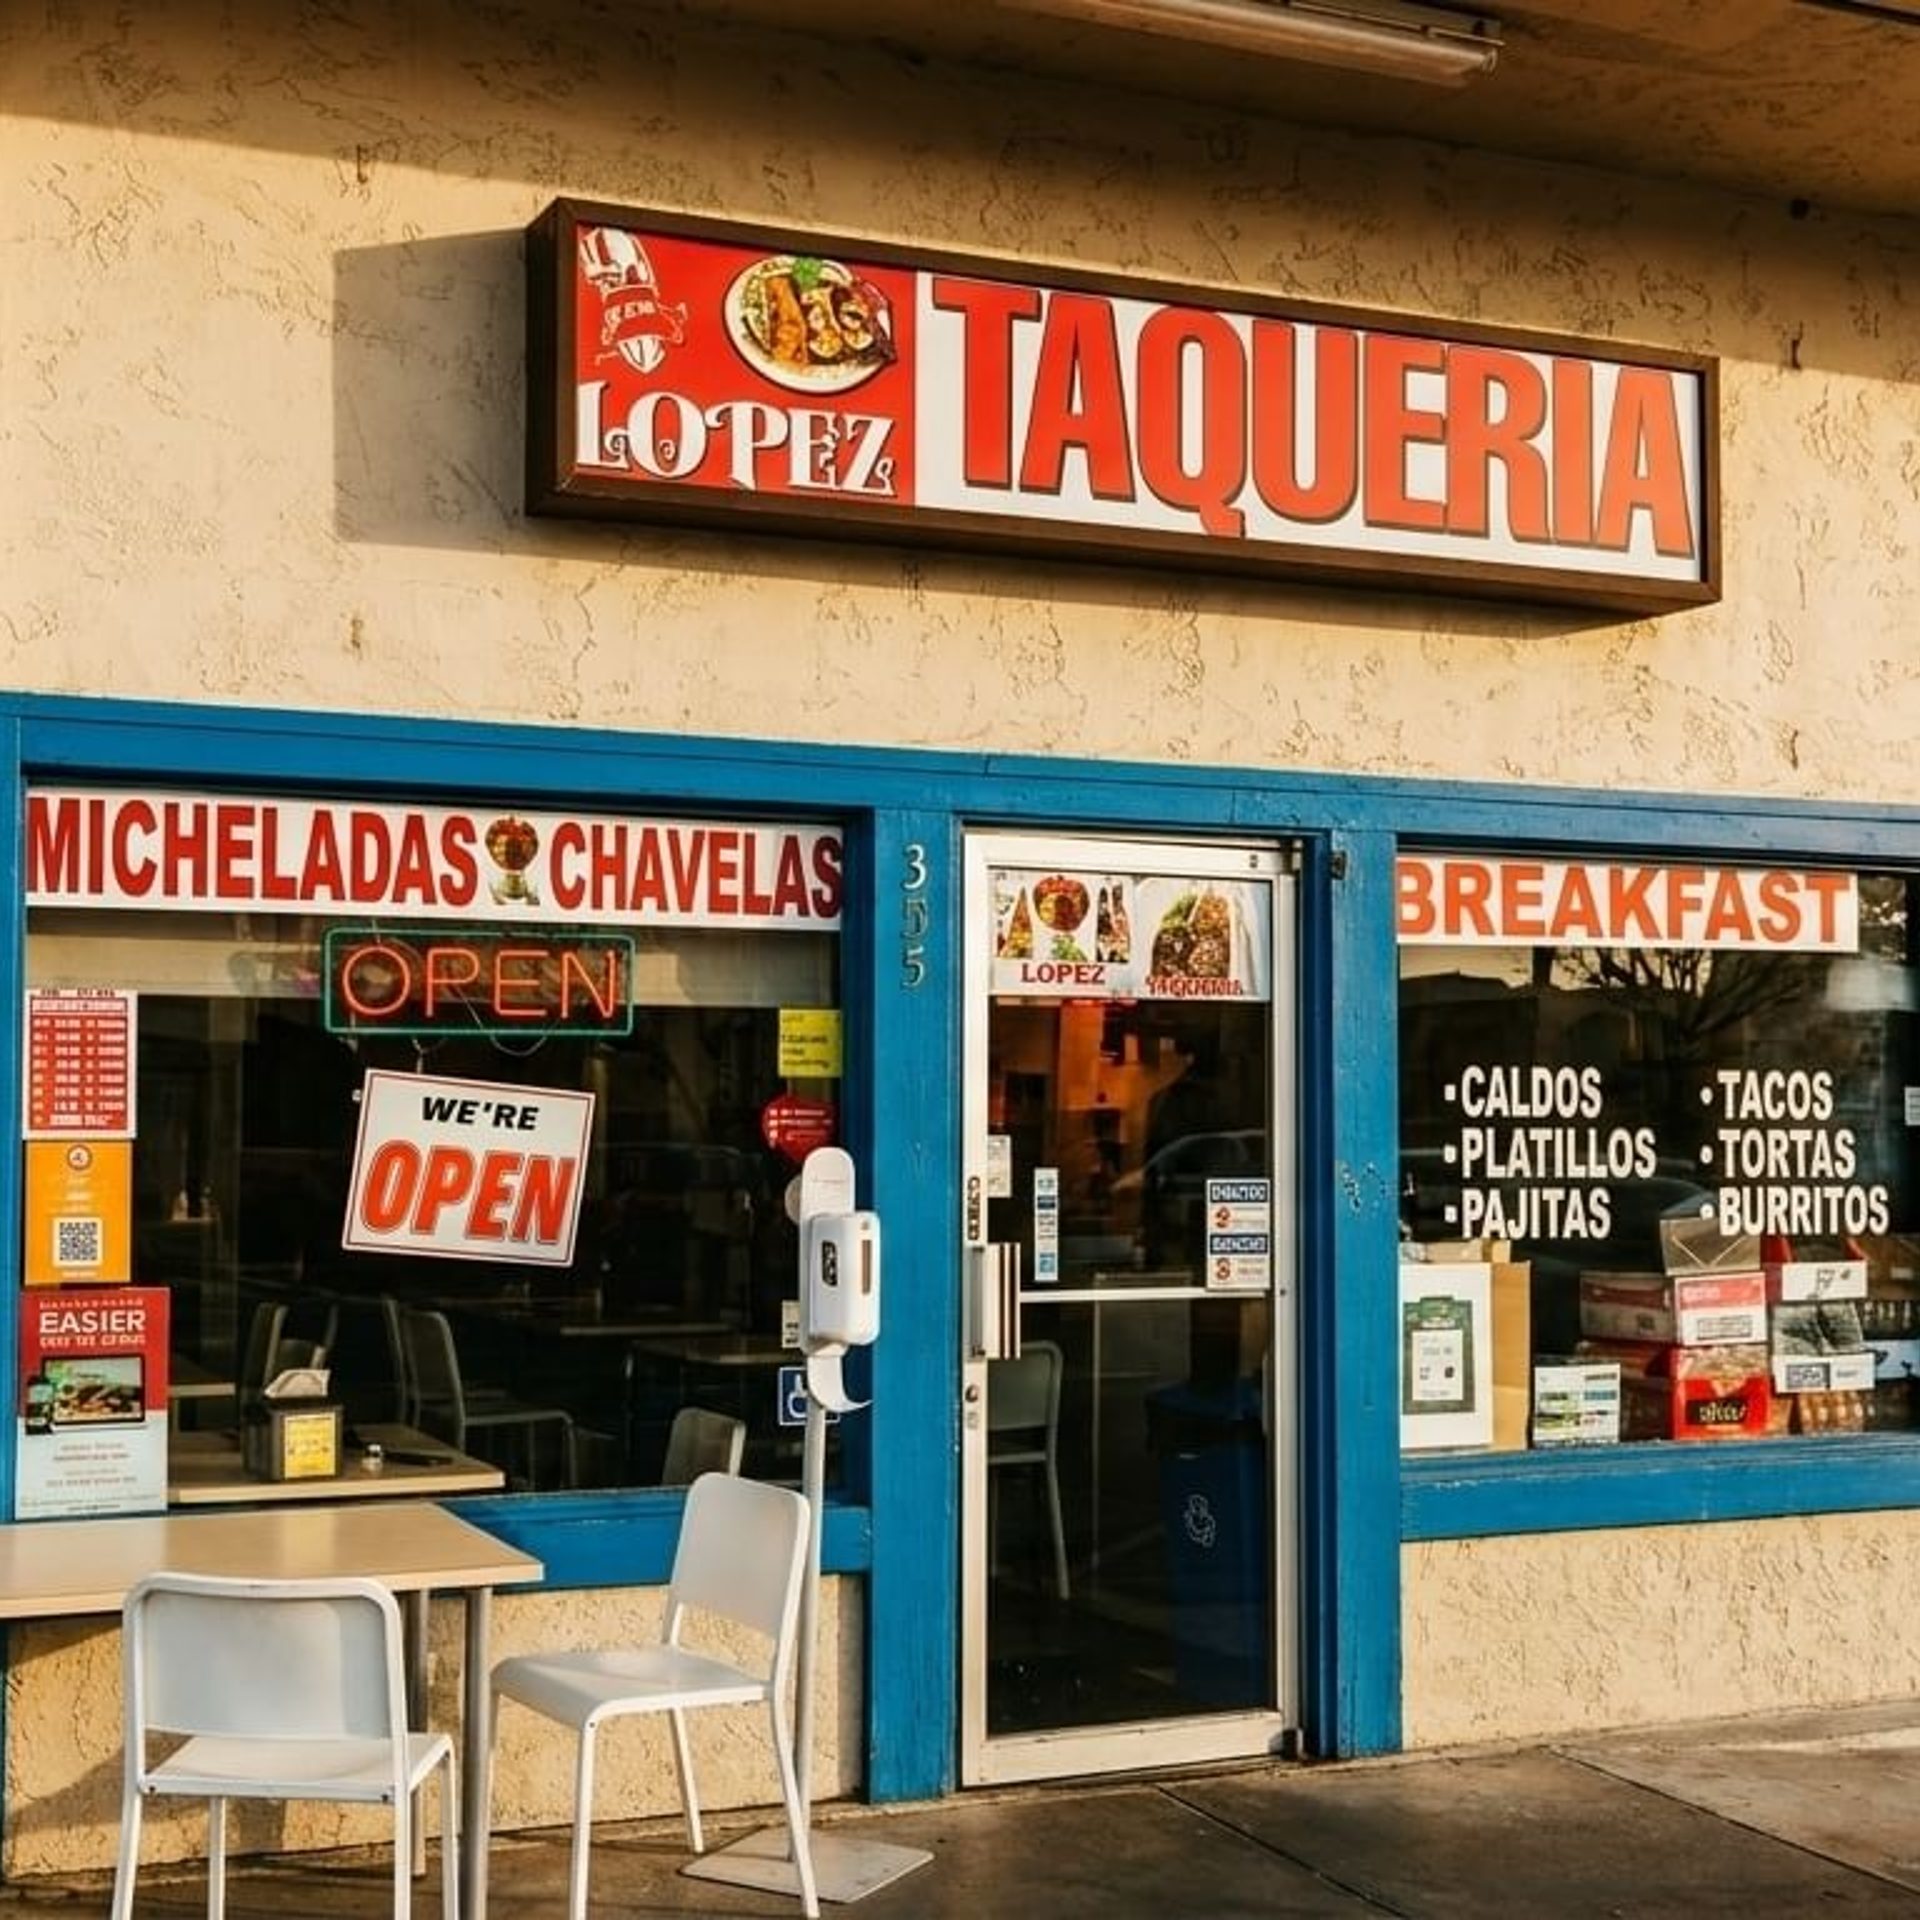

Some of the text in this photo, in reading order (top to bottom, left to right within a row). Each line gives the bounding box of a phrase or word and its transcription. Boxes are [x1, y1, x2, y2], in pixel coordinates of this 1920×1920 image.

[577, 381, 898, 497] LOPEZ
[932, 277, 1695, 559] TAQUERIA
[27, 797, 478, 907] MICHELADAS
[550, 822, 842, 919] CHAVELAS
[1397, 861, 1852, 943] BREAKFAST
[343, 946, 616, 1019] OPEN
[1021, 963, 1105, 984] LOPEZ
[422, 1096, 540, 1131] WE'RE
[1461, 1066, 1603, 1119] CALDOS
[1717, 1069, 1834, 1120] TACOS
[1461, 1127, 1657, 1179] PLATILLOS
[1718, 1128, 1857, 1180] TORTAS
[361, 1139, 577, 1245] OPEN
[1461, 1187, 1611, 1240] PAJITAS
[1718, 1185, 1889, 1236] BURRITOS
[39, 1310, 146, 1334] EASIER
